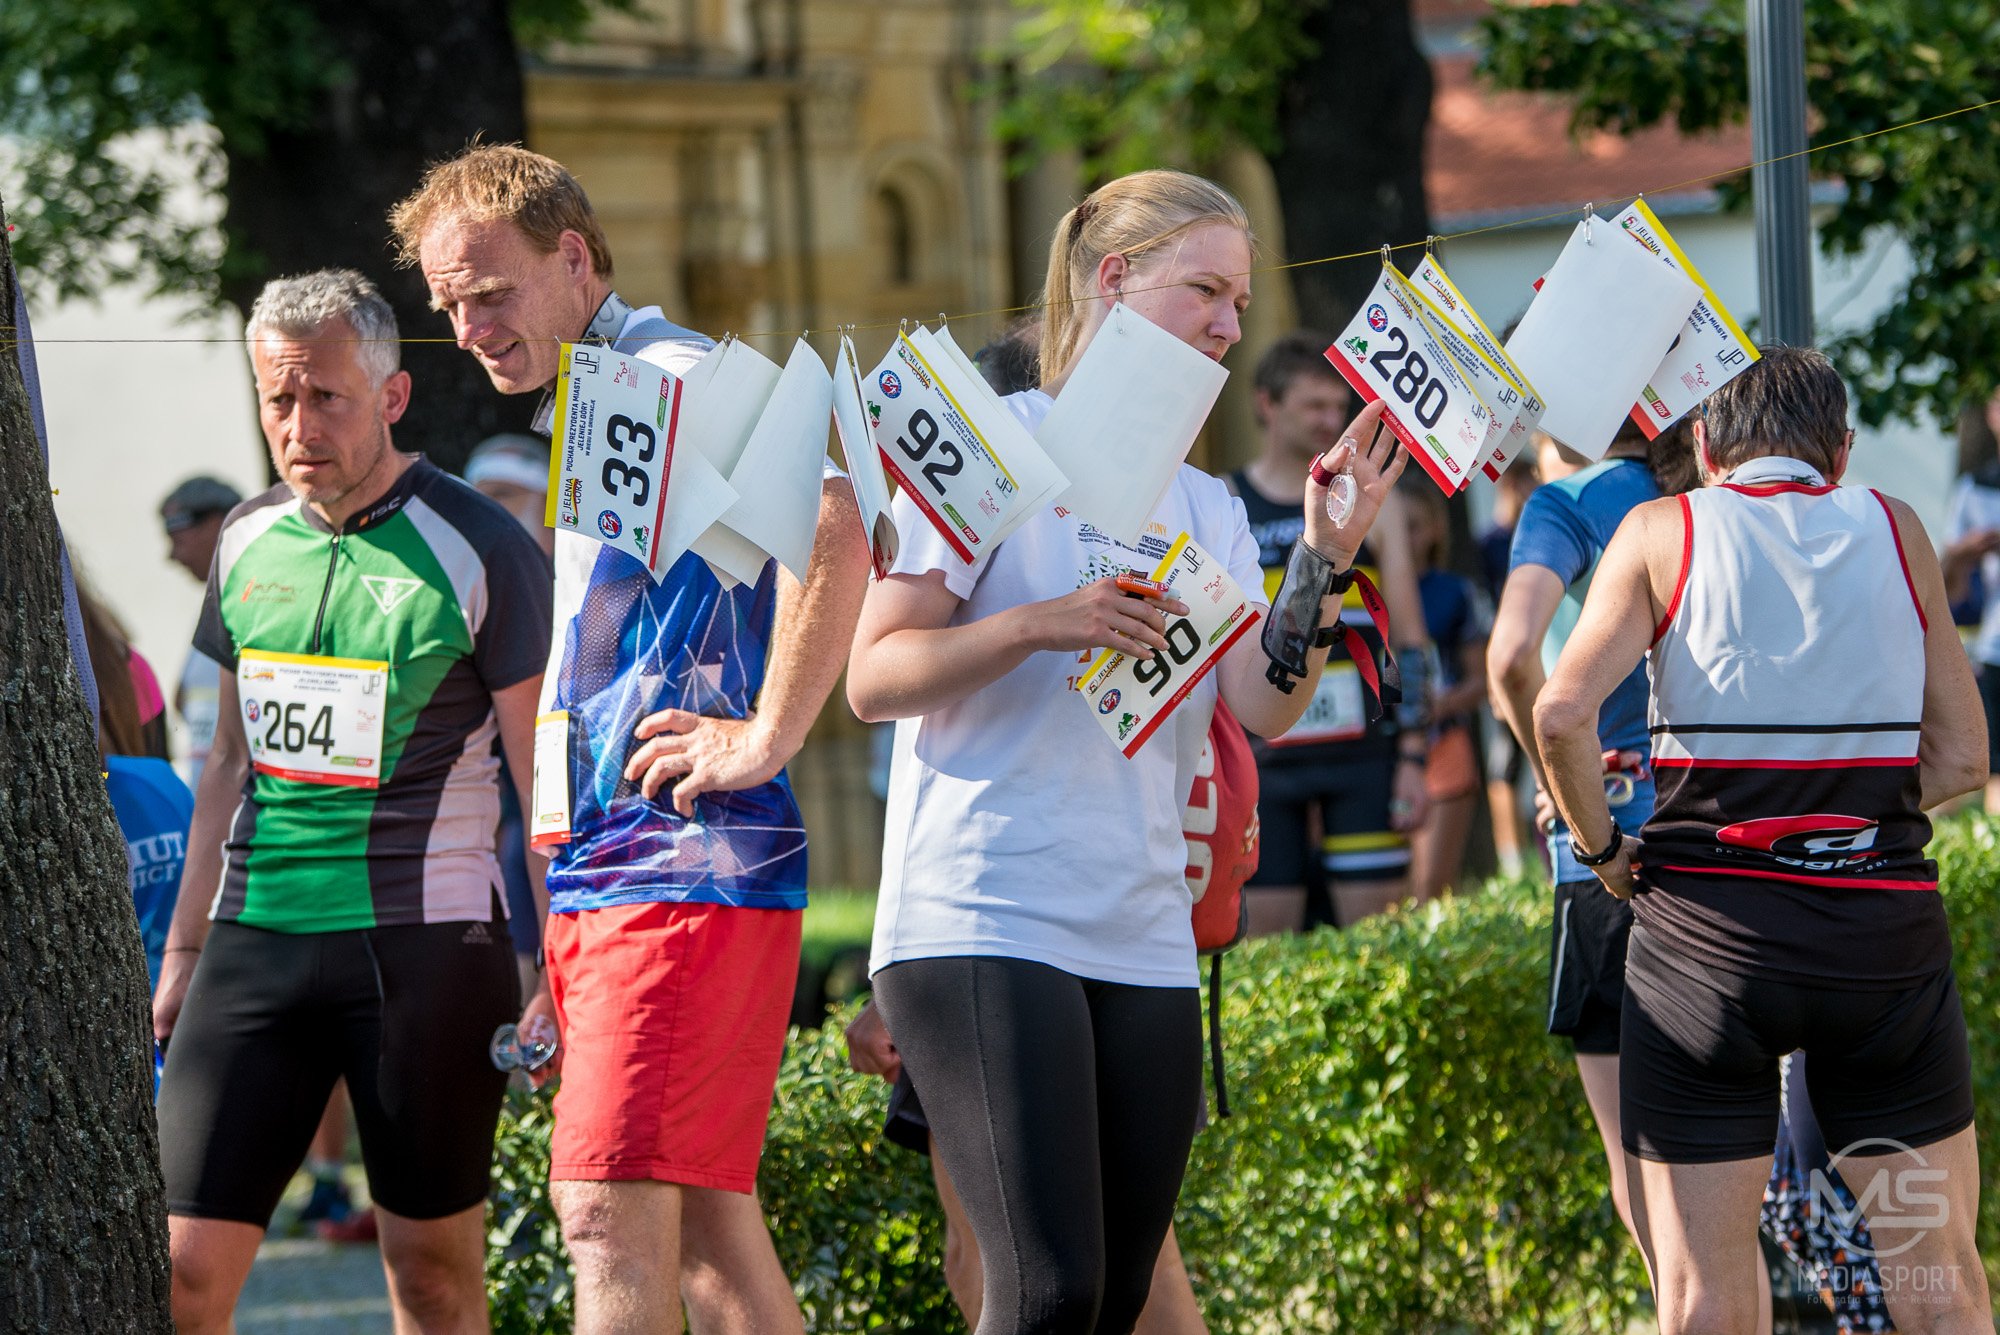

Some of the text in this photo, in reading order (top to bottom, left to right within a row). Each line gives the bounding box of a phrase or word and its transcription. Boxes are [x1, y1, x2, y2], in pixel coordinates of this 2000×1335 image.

[1635, 226, 1661, 256] JELENIA
[1427, 311, 1447, 333] PUCHAR
[1447, 331, 1479, 363] PREZYDENTA
[1479, 361, 1499, 382] MIASTA
[1709, 317, 1728, 340] MIASTA
[1370, 326, 1449, 430] 280
[566, 377, 581, 471] PUCHAR PREZYDENTA MIASTA
[577, 421, 586, 451] JELENIEJ
[935, 387, 997, 469] PUCHAR PREZYDENTA MIASTA
[947, 412, 967, 438] JELENIEJ
[602, 413, 656, 507] 33
[896, 408, 964, 497] 92
[563, 478, 573, 510] JELENIA
[964, 527, 977, 542] PZOS
[1167, 568, 1180, 587] IASTA
[1132, 618, 1201, 698] 90
[263, 700, 335, 756] 264
